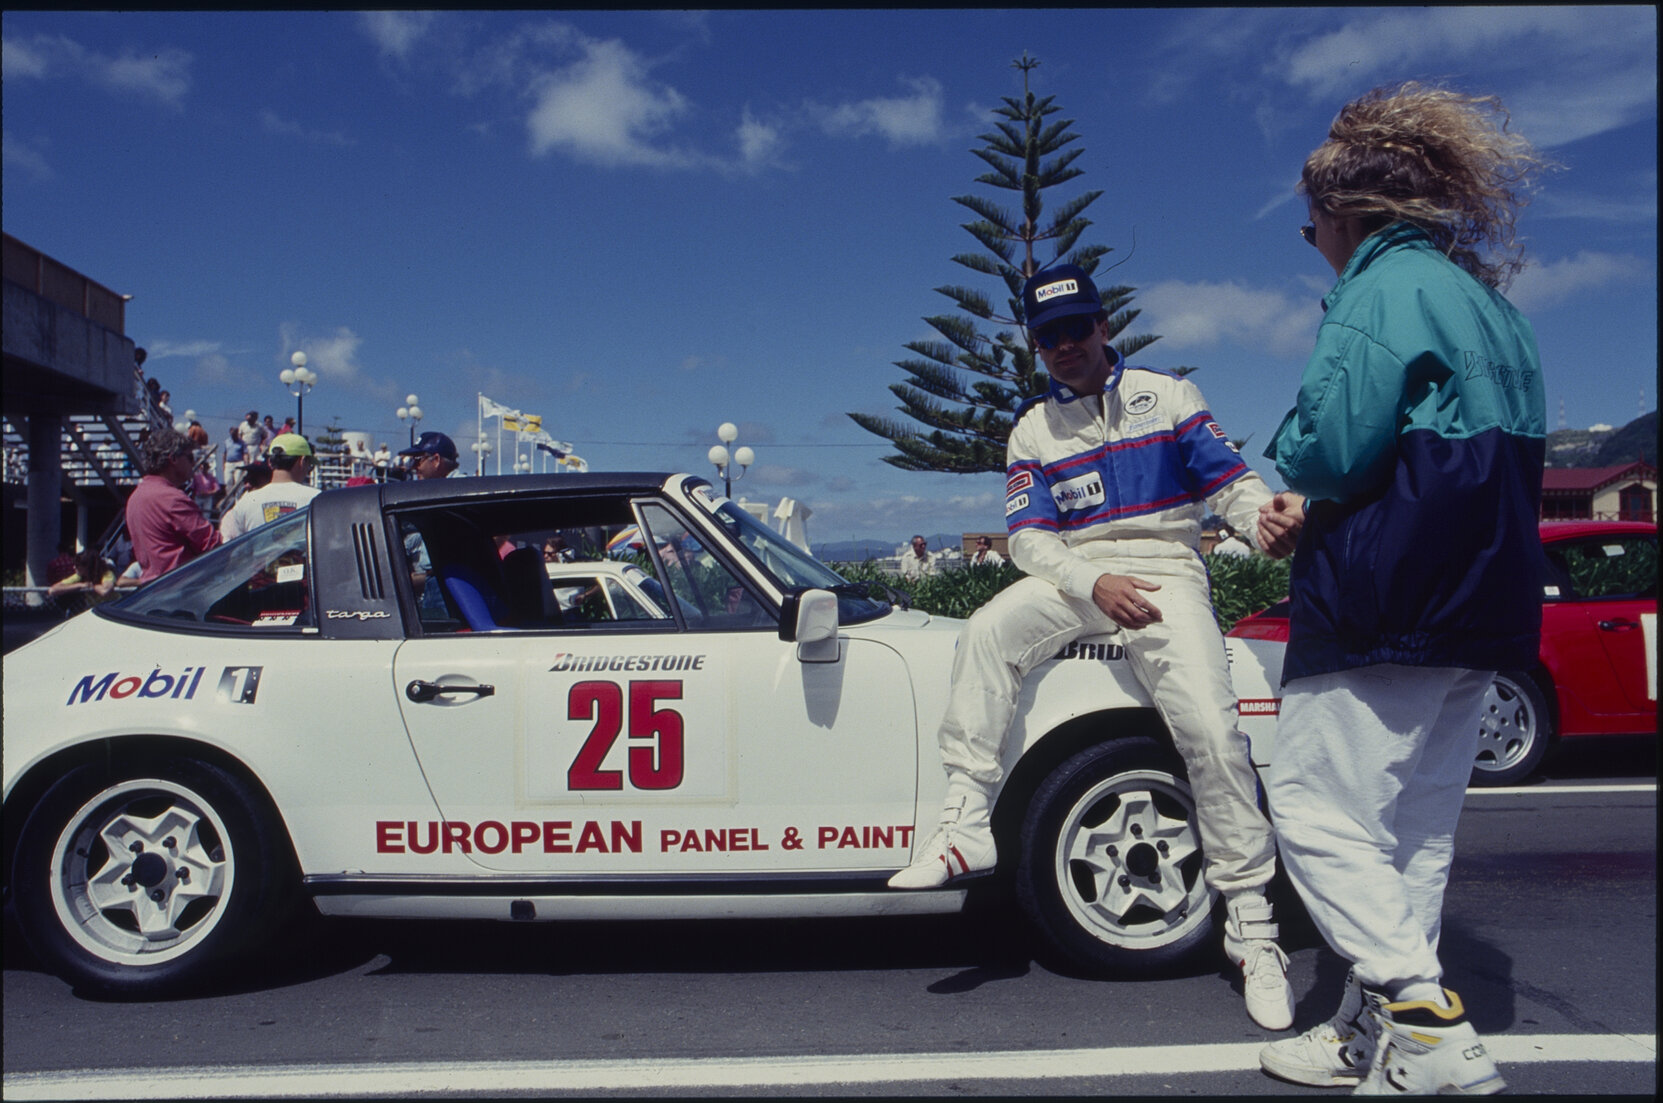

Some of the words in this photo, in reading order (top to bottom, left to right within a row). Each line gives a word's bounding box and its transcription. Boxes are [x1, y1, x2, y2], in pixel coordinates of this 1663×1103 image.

[1038, 284, 1064, 299] Mobil
[1055, 487, 1086, 505] Mobil
[326, 609, 391, 622] targa
[549, 653, 705, 672] BRIDGESTONE
[67, 667, 206, 706] Mobil
[225, 667, 257, 704] 1
[567, 680, 684, 791] 25
[376, 820, 643, 855] EUROPEAN
[660, 828, 769, 851] PANEL
[781, 826, 804, 850] &
[818, 825, 915, 849] PAINT
